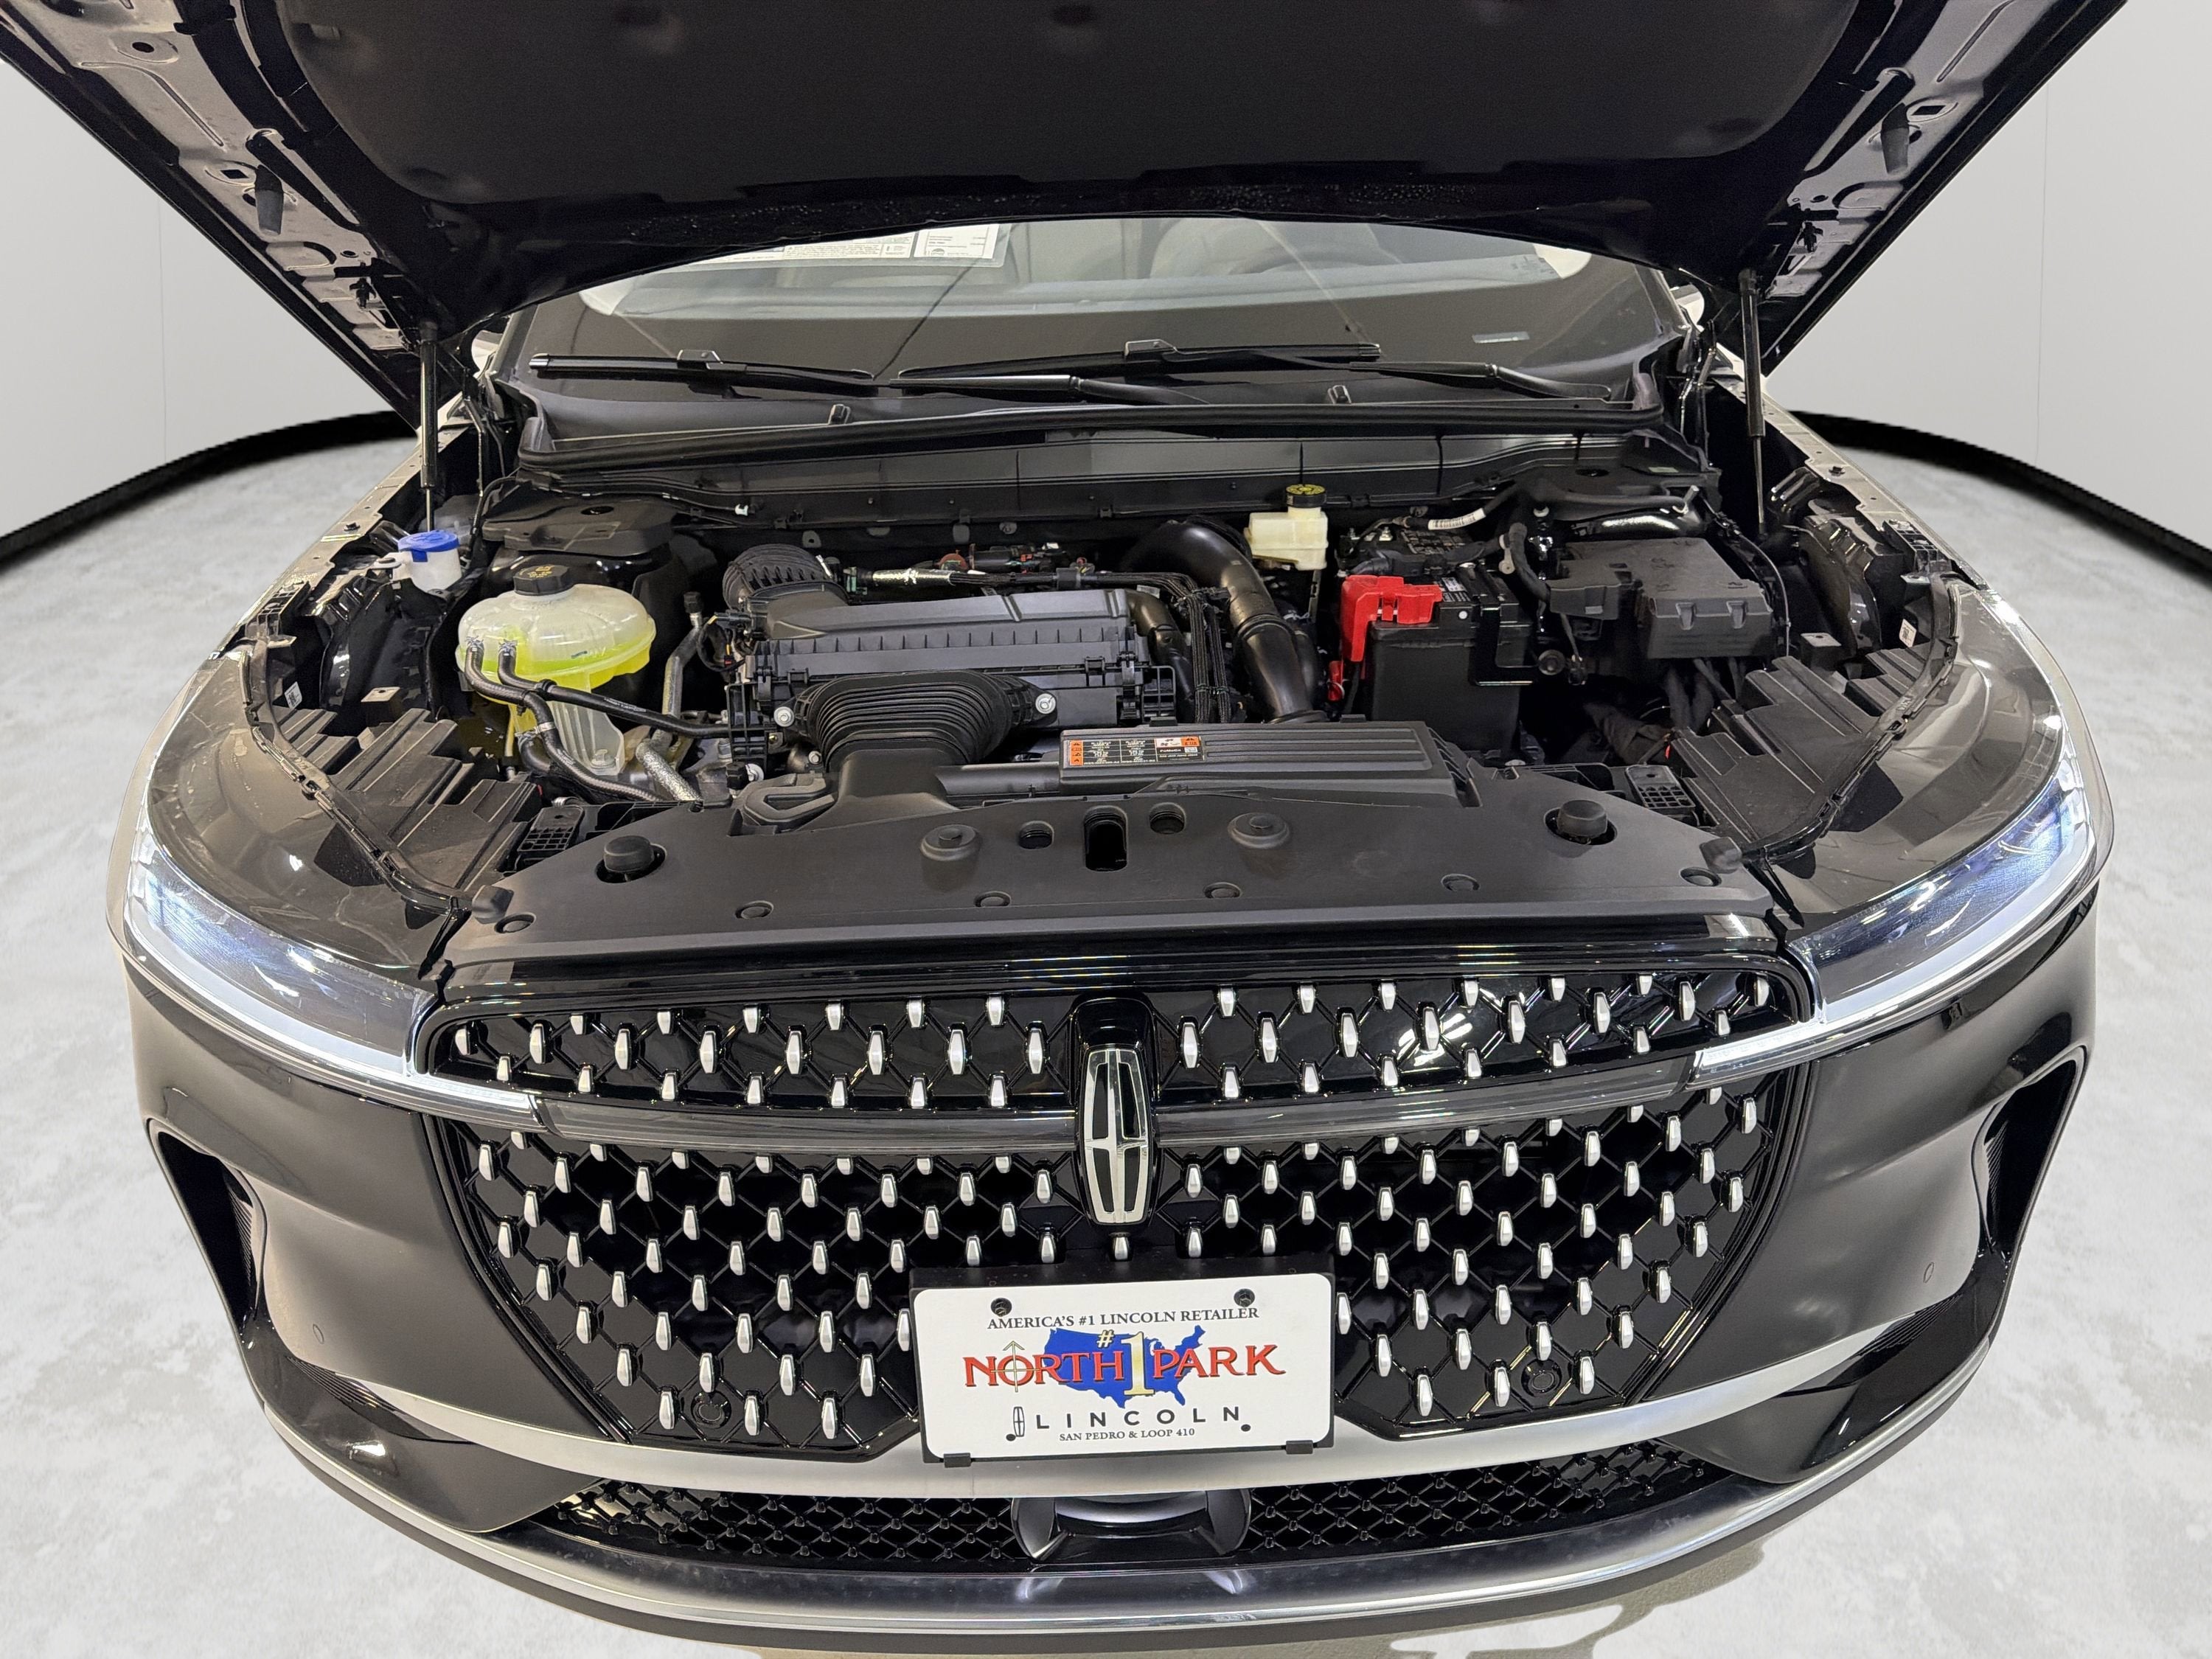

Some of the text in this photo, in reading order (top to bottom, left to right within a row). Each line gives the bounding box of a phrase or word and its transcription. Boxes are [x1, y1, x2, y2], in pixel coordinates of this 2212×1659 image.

[987, 1307, 1260, 1329] AMERICA'S #1 LINCOLN RETAILER
[963, 1344, 1287, 1387] NORTH PARK
[1035, 1406, 1239, 1429] LINCOLN
[1059, 1432, 1082, 1441] SAN
[1085, 1430, 1125, 1440] PEDRO
[1141, 1429, 1173, 1438] LOOP
[1175, 1427, 1195, 1436] 410
